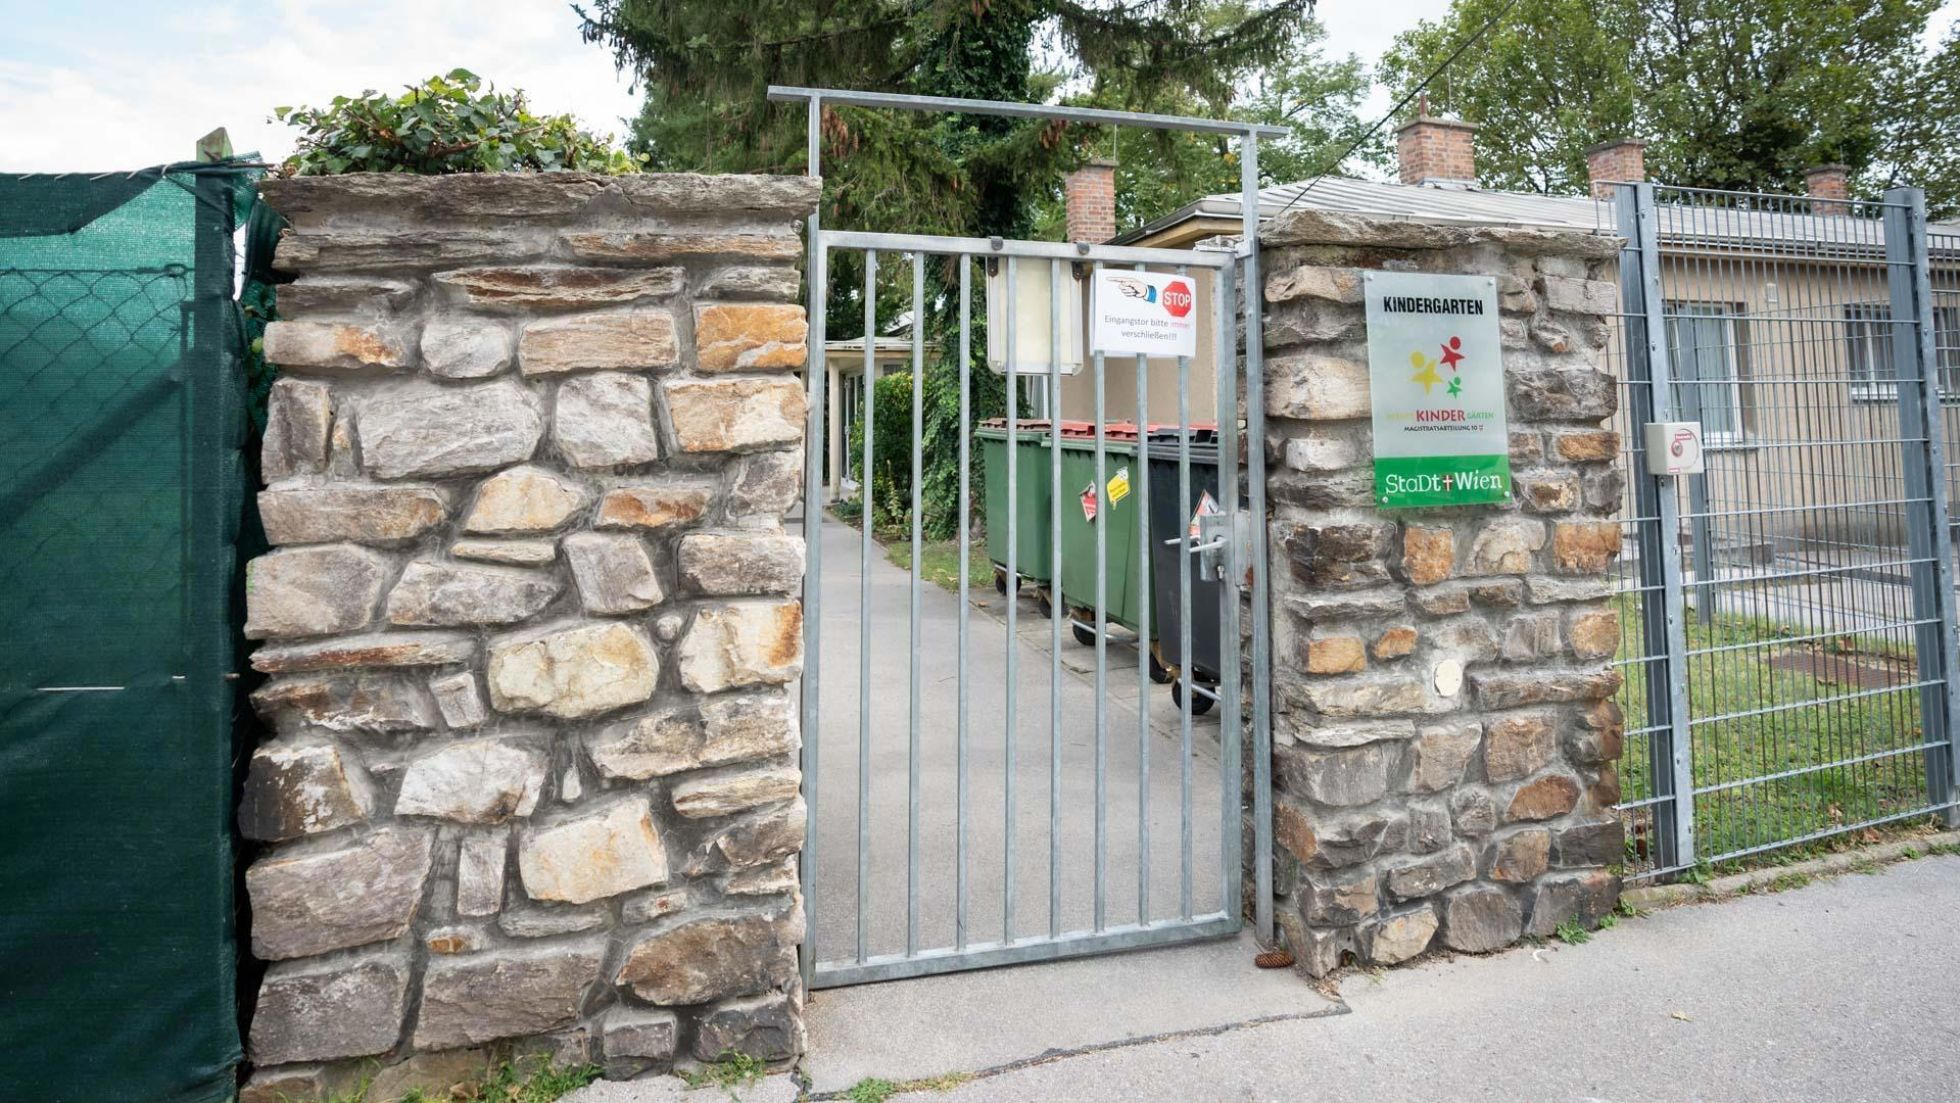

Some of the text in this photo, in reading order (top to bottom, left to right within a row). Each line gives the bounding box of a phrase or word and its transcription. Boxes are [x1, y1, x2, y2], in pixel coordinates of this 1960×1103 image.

[1163, 291, 1191, 307] STOP
[1383, 296, 1483, 315] KINDERGARTEN
[1104, 315, 1148, 327] Eingangstor
[1150, 318, 1169, 327] bitte
[1416, 409, 1466, 422] KINDER
[1454, 469, 1503, 490] Wien
